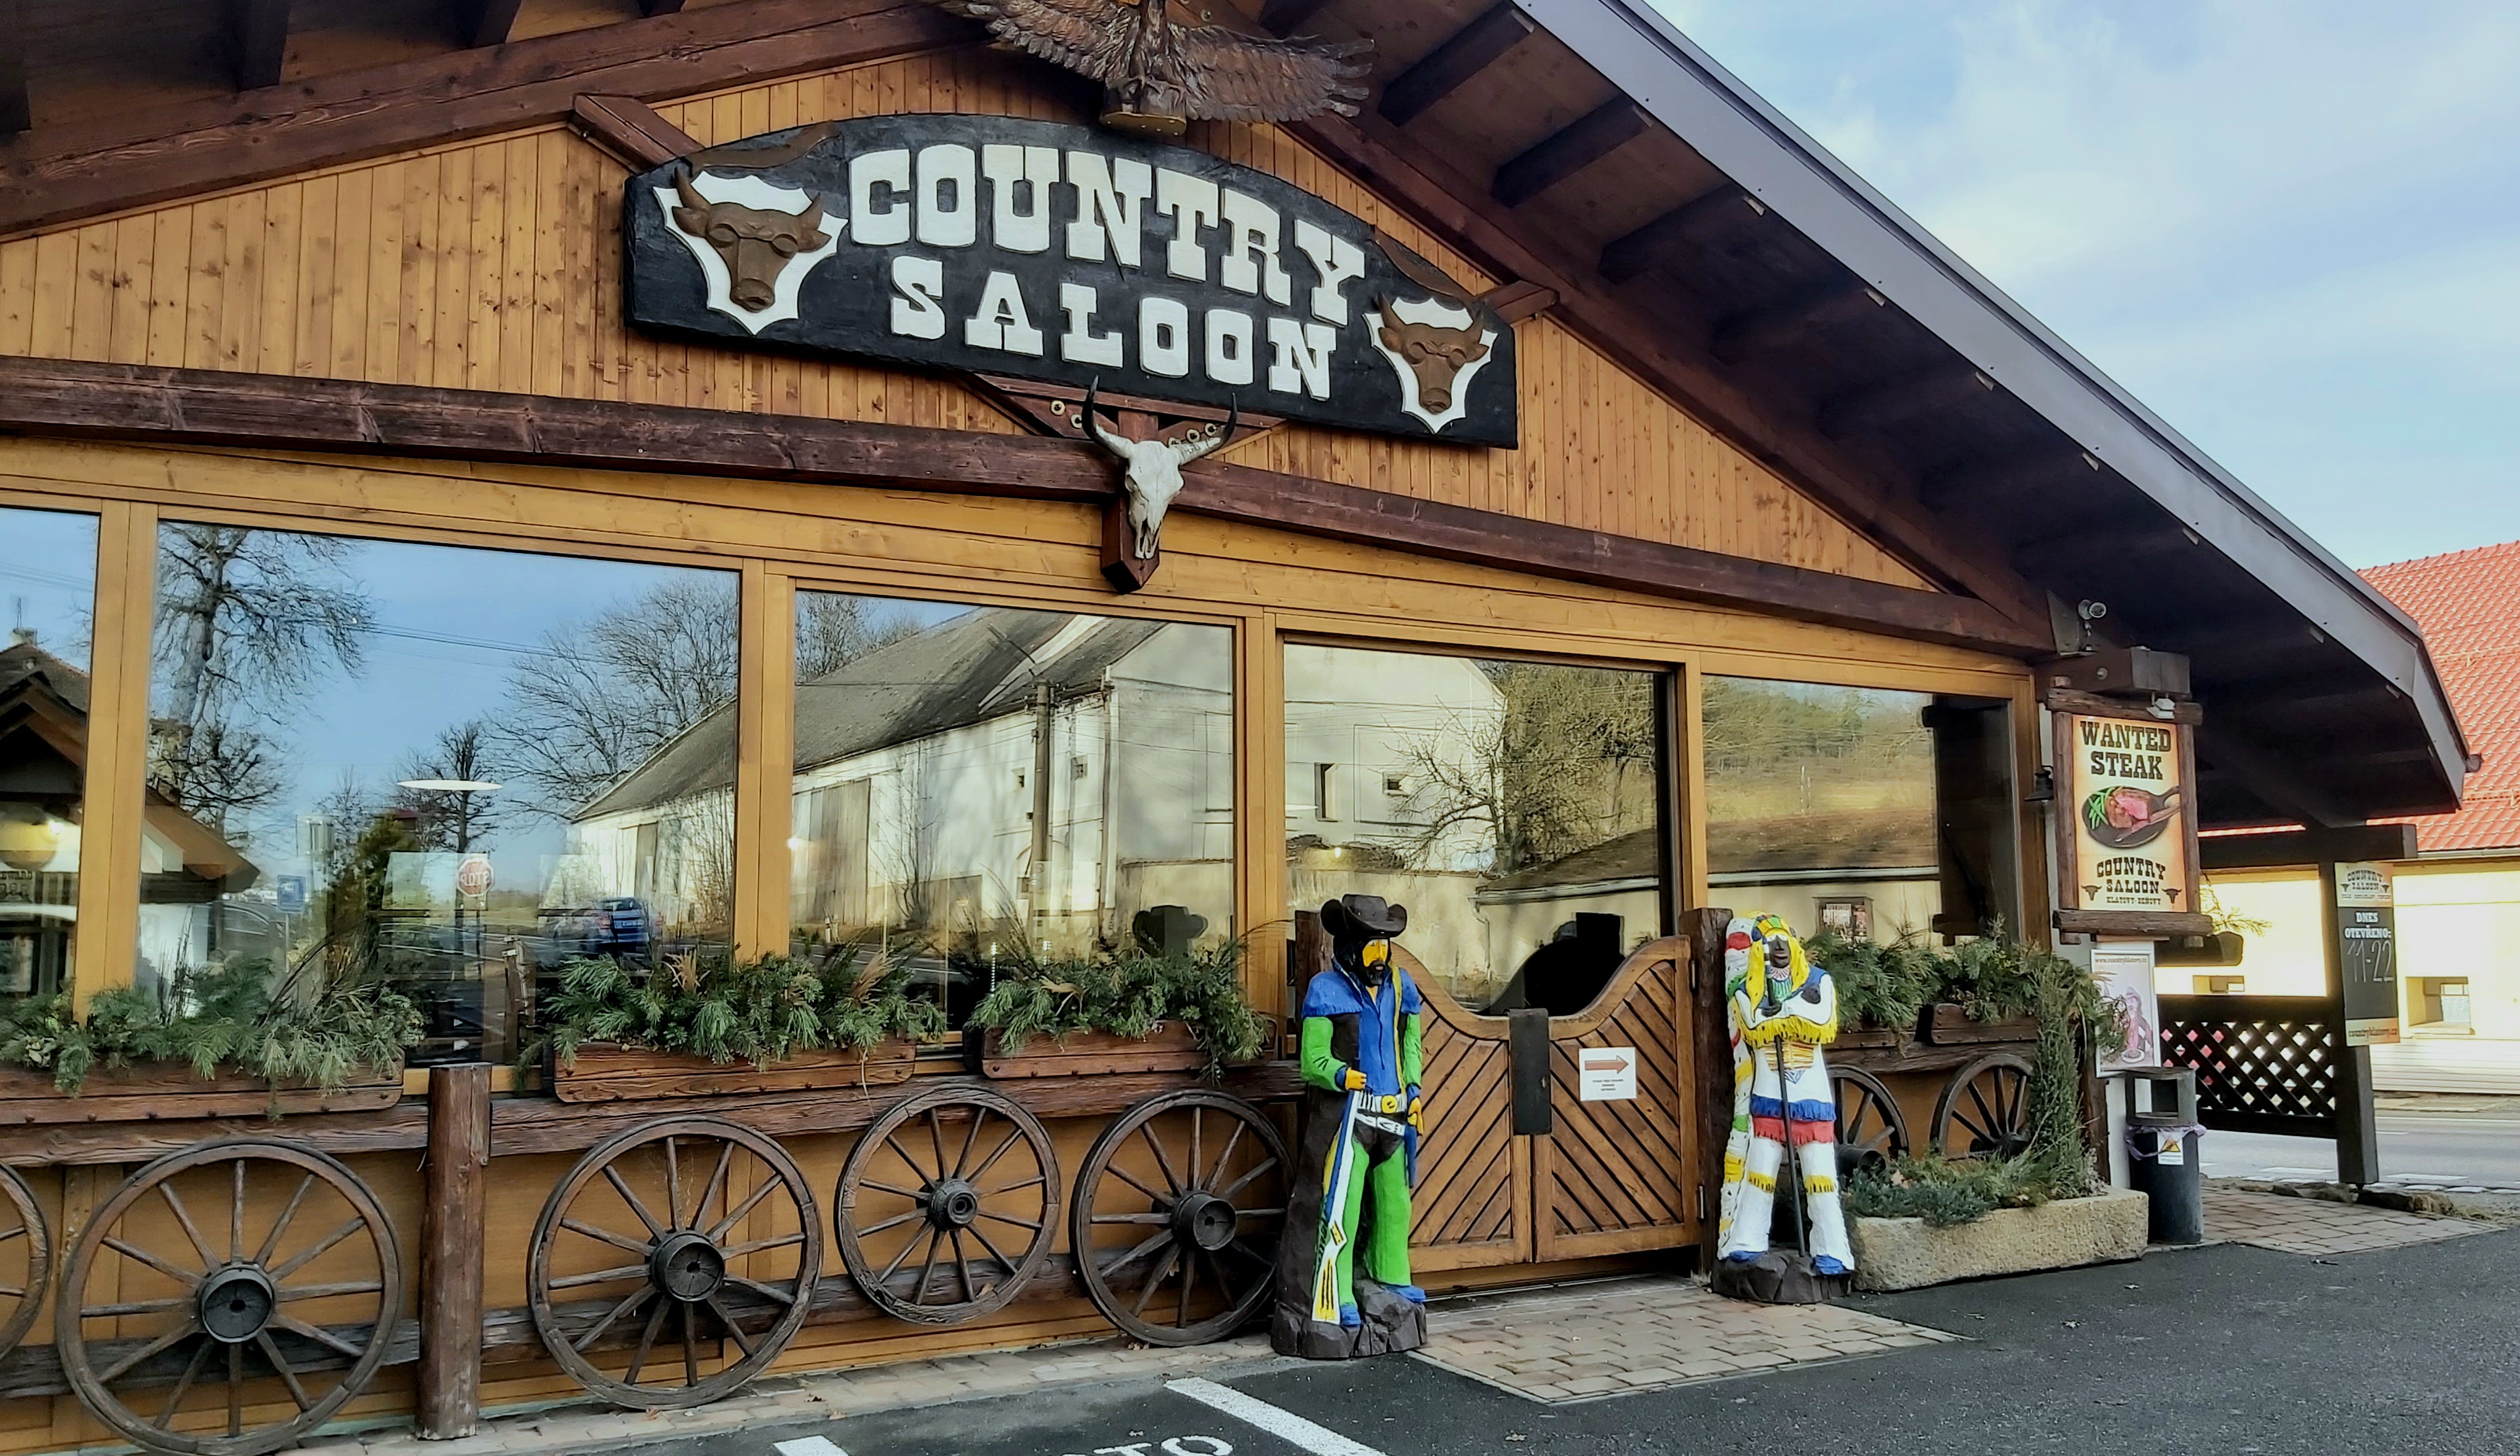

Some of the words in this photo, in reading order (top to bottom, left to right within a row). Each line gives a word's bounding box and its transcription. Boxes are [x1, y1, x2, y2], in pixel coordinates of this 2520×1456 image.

[849, 143, 1366, 326] COUNTRY
[890, 255, 1338, 400] SALOON
[2080, 720, 2171, 752] WANTED
[2091, 751, 2163, 780] STEAK
[2097, 857, 2165, 880] COUNTRY
[2347, 870, 2383, 882] COUNTRY
[2106, 879, 2159, 894] SALOON
[2356, 912, 2379, 923] DNES
[2345, 924, 2392, 938] OTEVŘENO:
